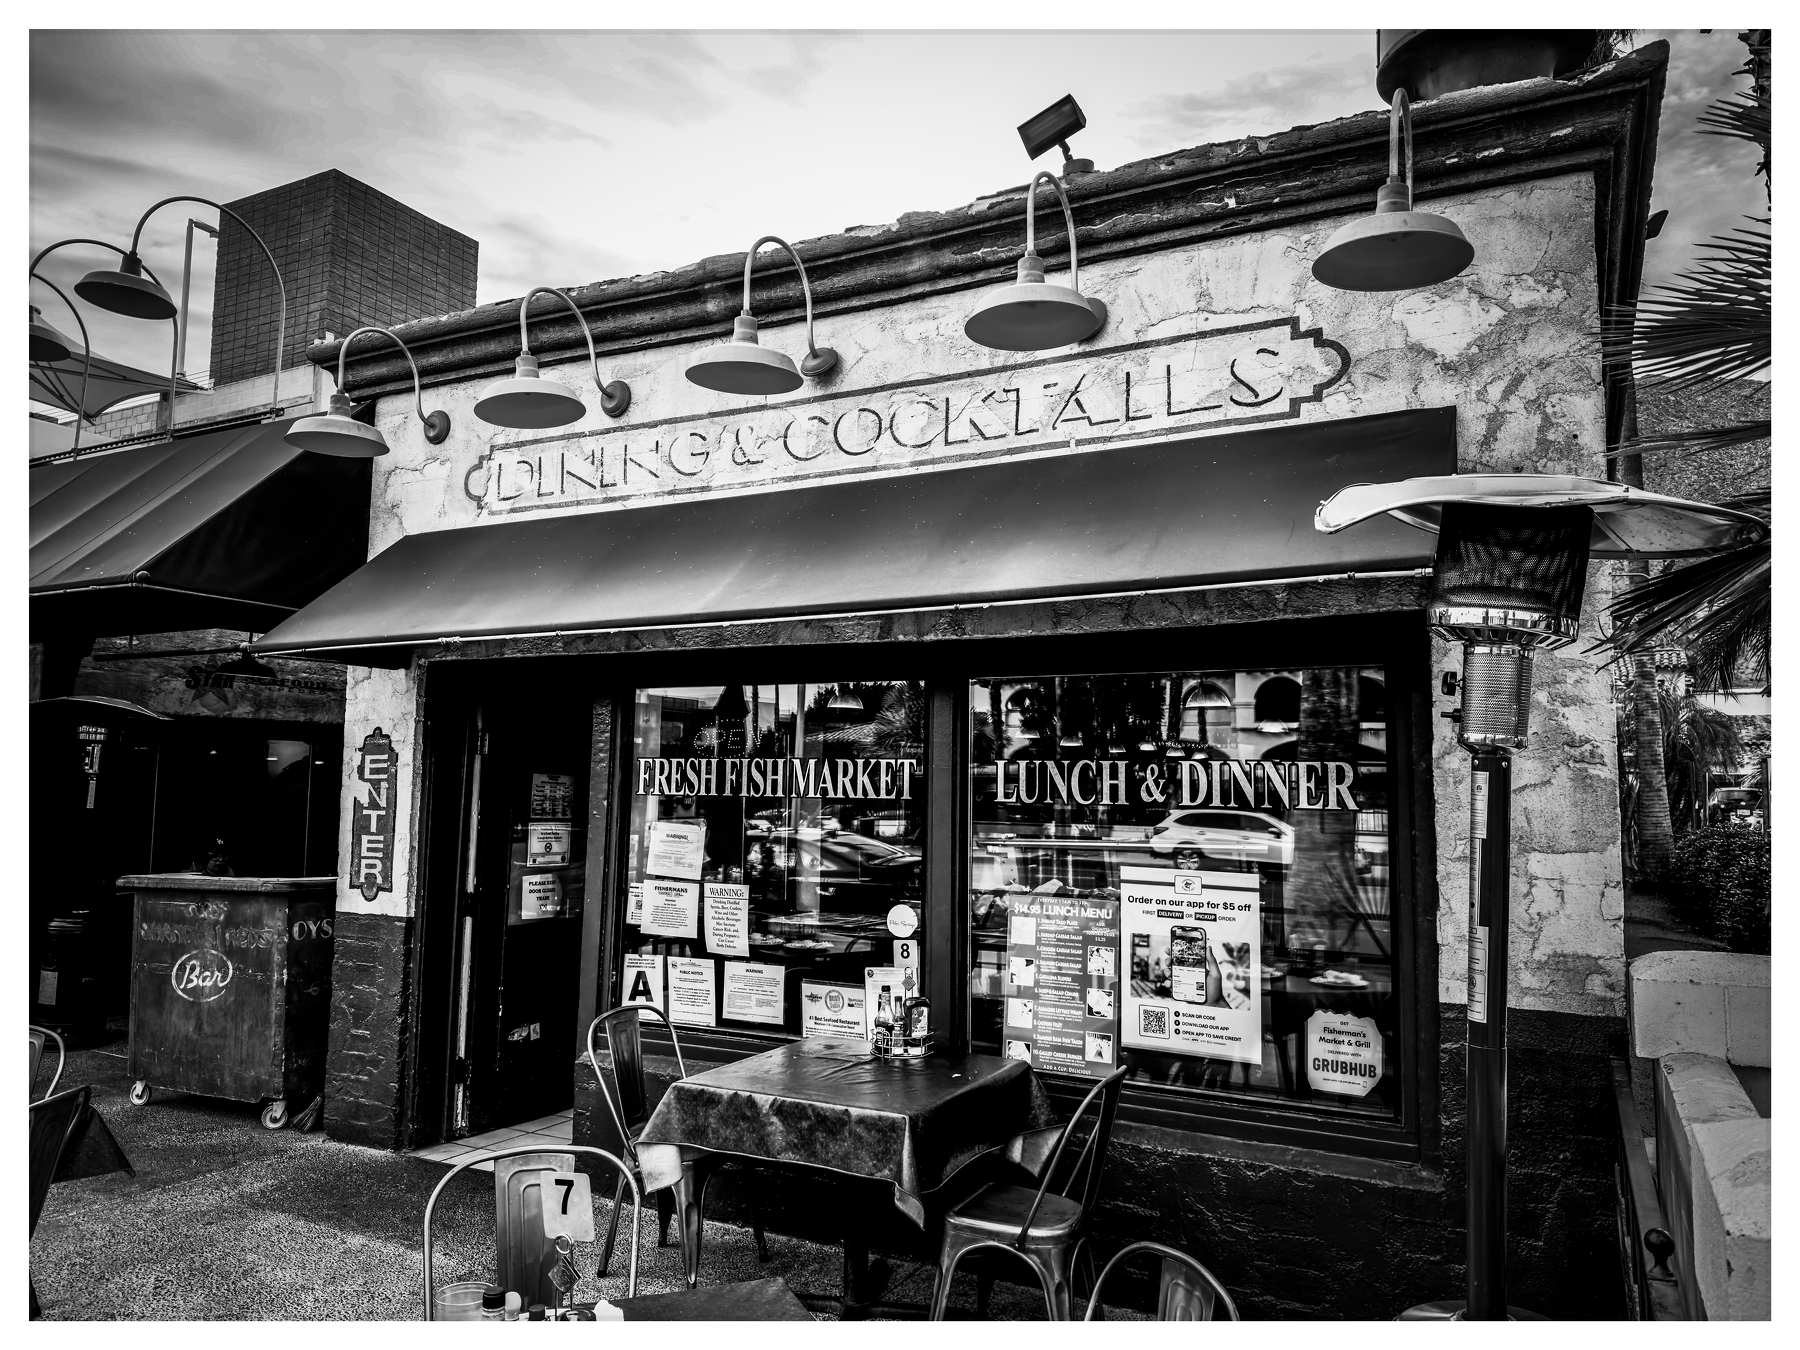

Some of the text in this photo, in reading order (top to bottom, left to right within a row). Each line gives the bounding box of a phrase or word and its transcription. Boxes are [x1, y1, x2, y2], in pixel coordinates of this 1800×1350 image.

[497, 348, 1284, 501] DINING & COCKTAILS
[637, 757, 919, 800] FRESH FISH MARKET
[994, 759, 1360, 812] LUNCH & DINNER
[359, 753, 389, 885] ENTER
[710, 888, 744, 897] WARNING:
[1128, 895, 1153, 905] Order
[1186, 901, 1204, 909] app
[1207, 901, 1220, 909] for
[1222, 902, 1235, 911] $5
[1014, 902, 1112, 919] $14.95 LUNCH MENU
[292, 919, 333, 941] OYS
[900, 943, 910, 959] 8
[179, 959, 227, 989] Bar
[628, 971, 654, 1002] A
[1319, 1036, 1345, 1045] Market
[1324, 1027, 1366, 1038] Fisherman's
[1313, 1058, 1377, 1078] GRUBHUB
[553, 1179, 574, 1216] 7
